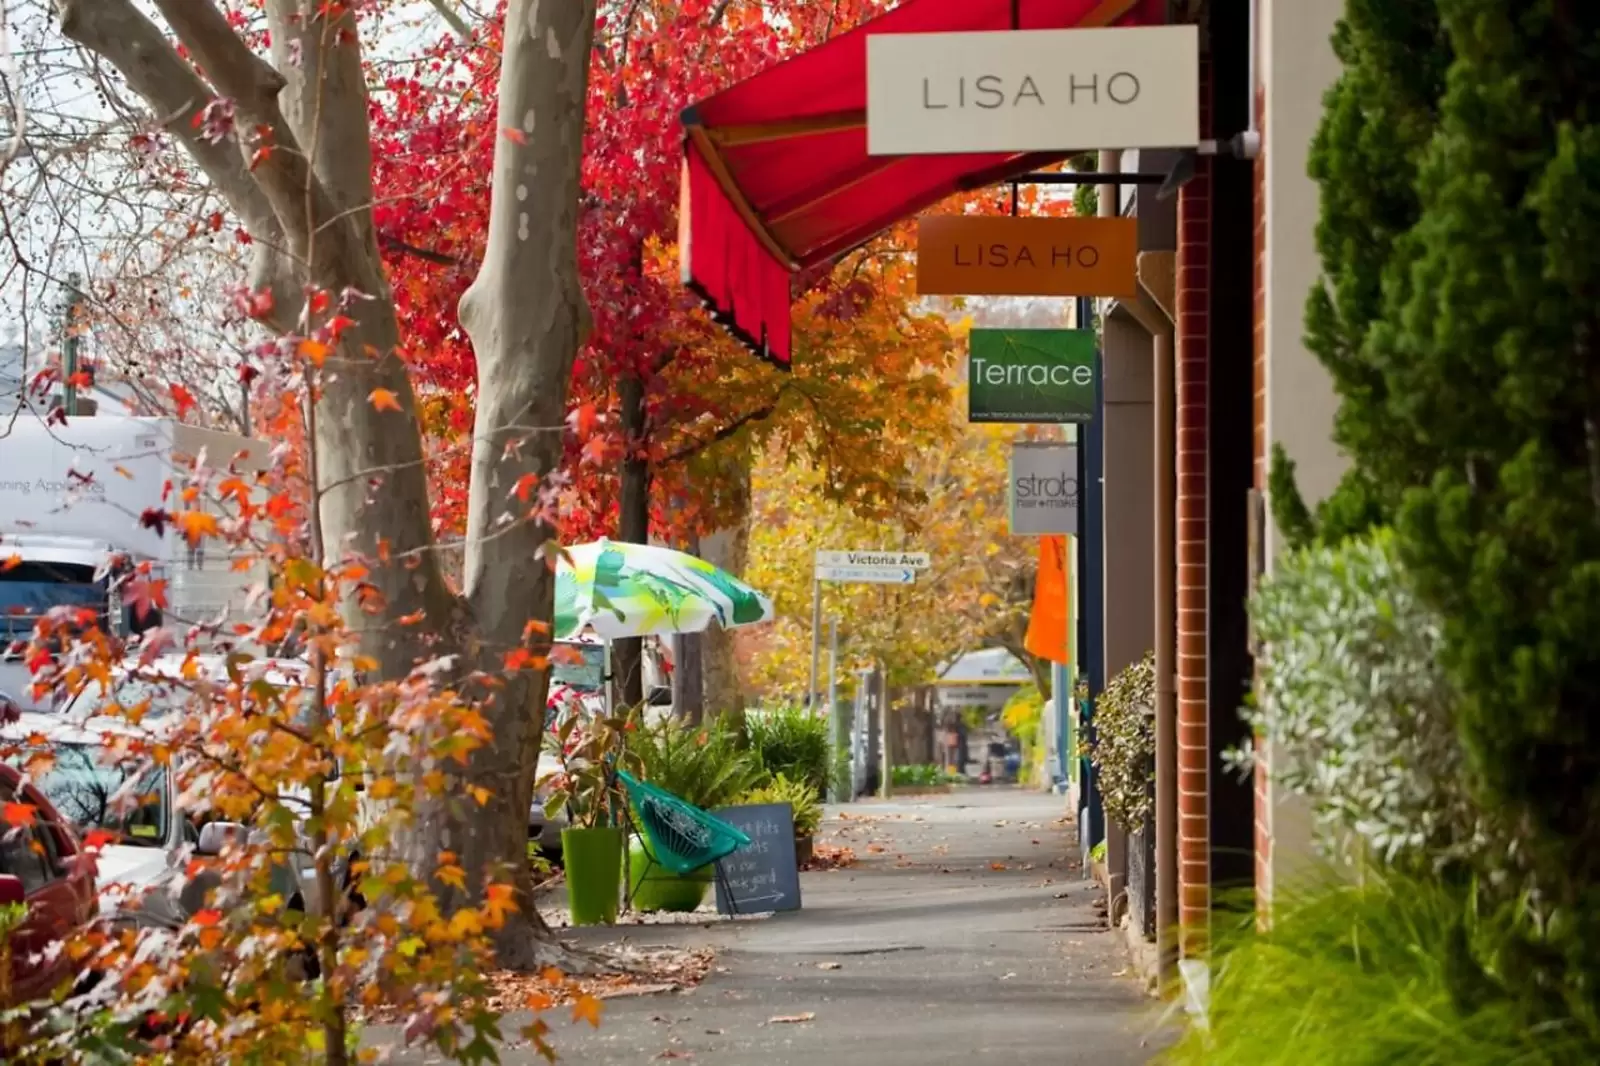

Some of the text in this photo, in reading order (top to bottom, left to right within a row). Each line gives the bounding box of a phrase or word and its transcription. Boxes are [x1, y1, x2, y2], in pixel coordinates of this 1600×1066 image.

[923, 71, 1140, 109] LISA HO
[954, 244, 1099, 268] LISA HO
[971, 357, 1093, 386] Terrace
[848, 553, 925, 565] Victoria Ave
